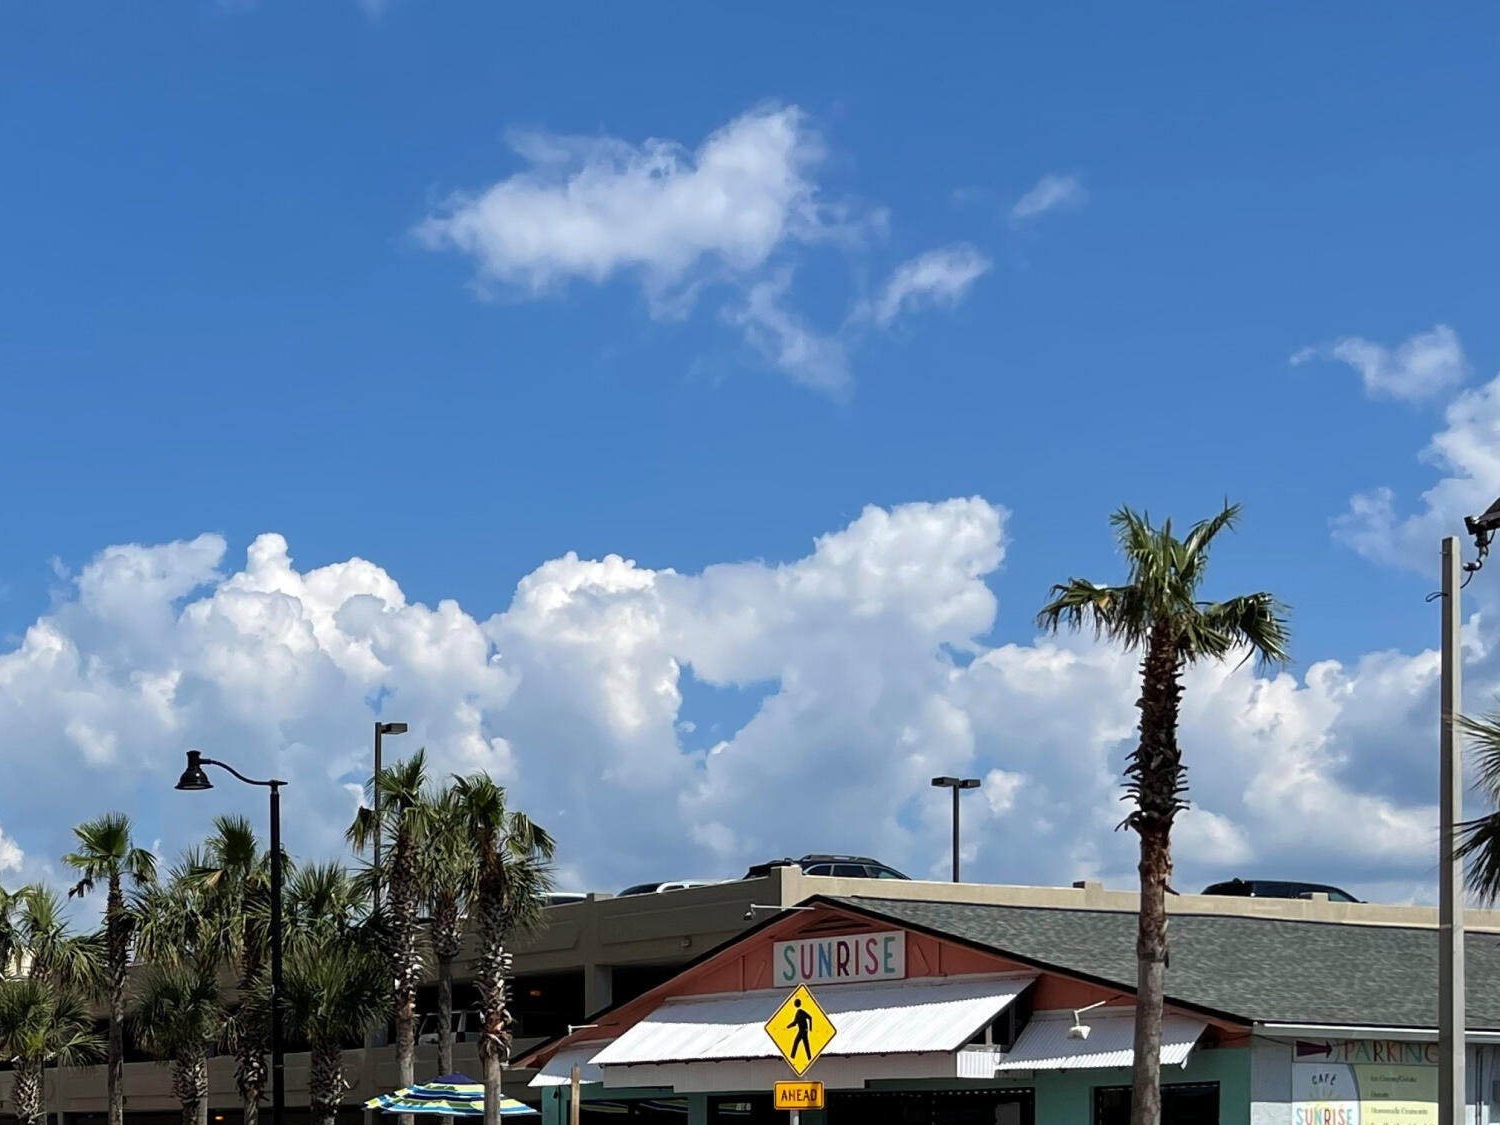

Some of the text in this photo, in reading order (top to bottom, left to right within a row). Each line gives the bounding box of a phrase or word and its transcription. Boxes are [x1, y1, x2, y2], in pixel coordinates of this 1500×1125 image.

[782, 936, 896, 981] SUNRISE
[781, 1089, 817, 1101] AHEAD
[1295, 1108, 1353, 1125] SUNRISE
